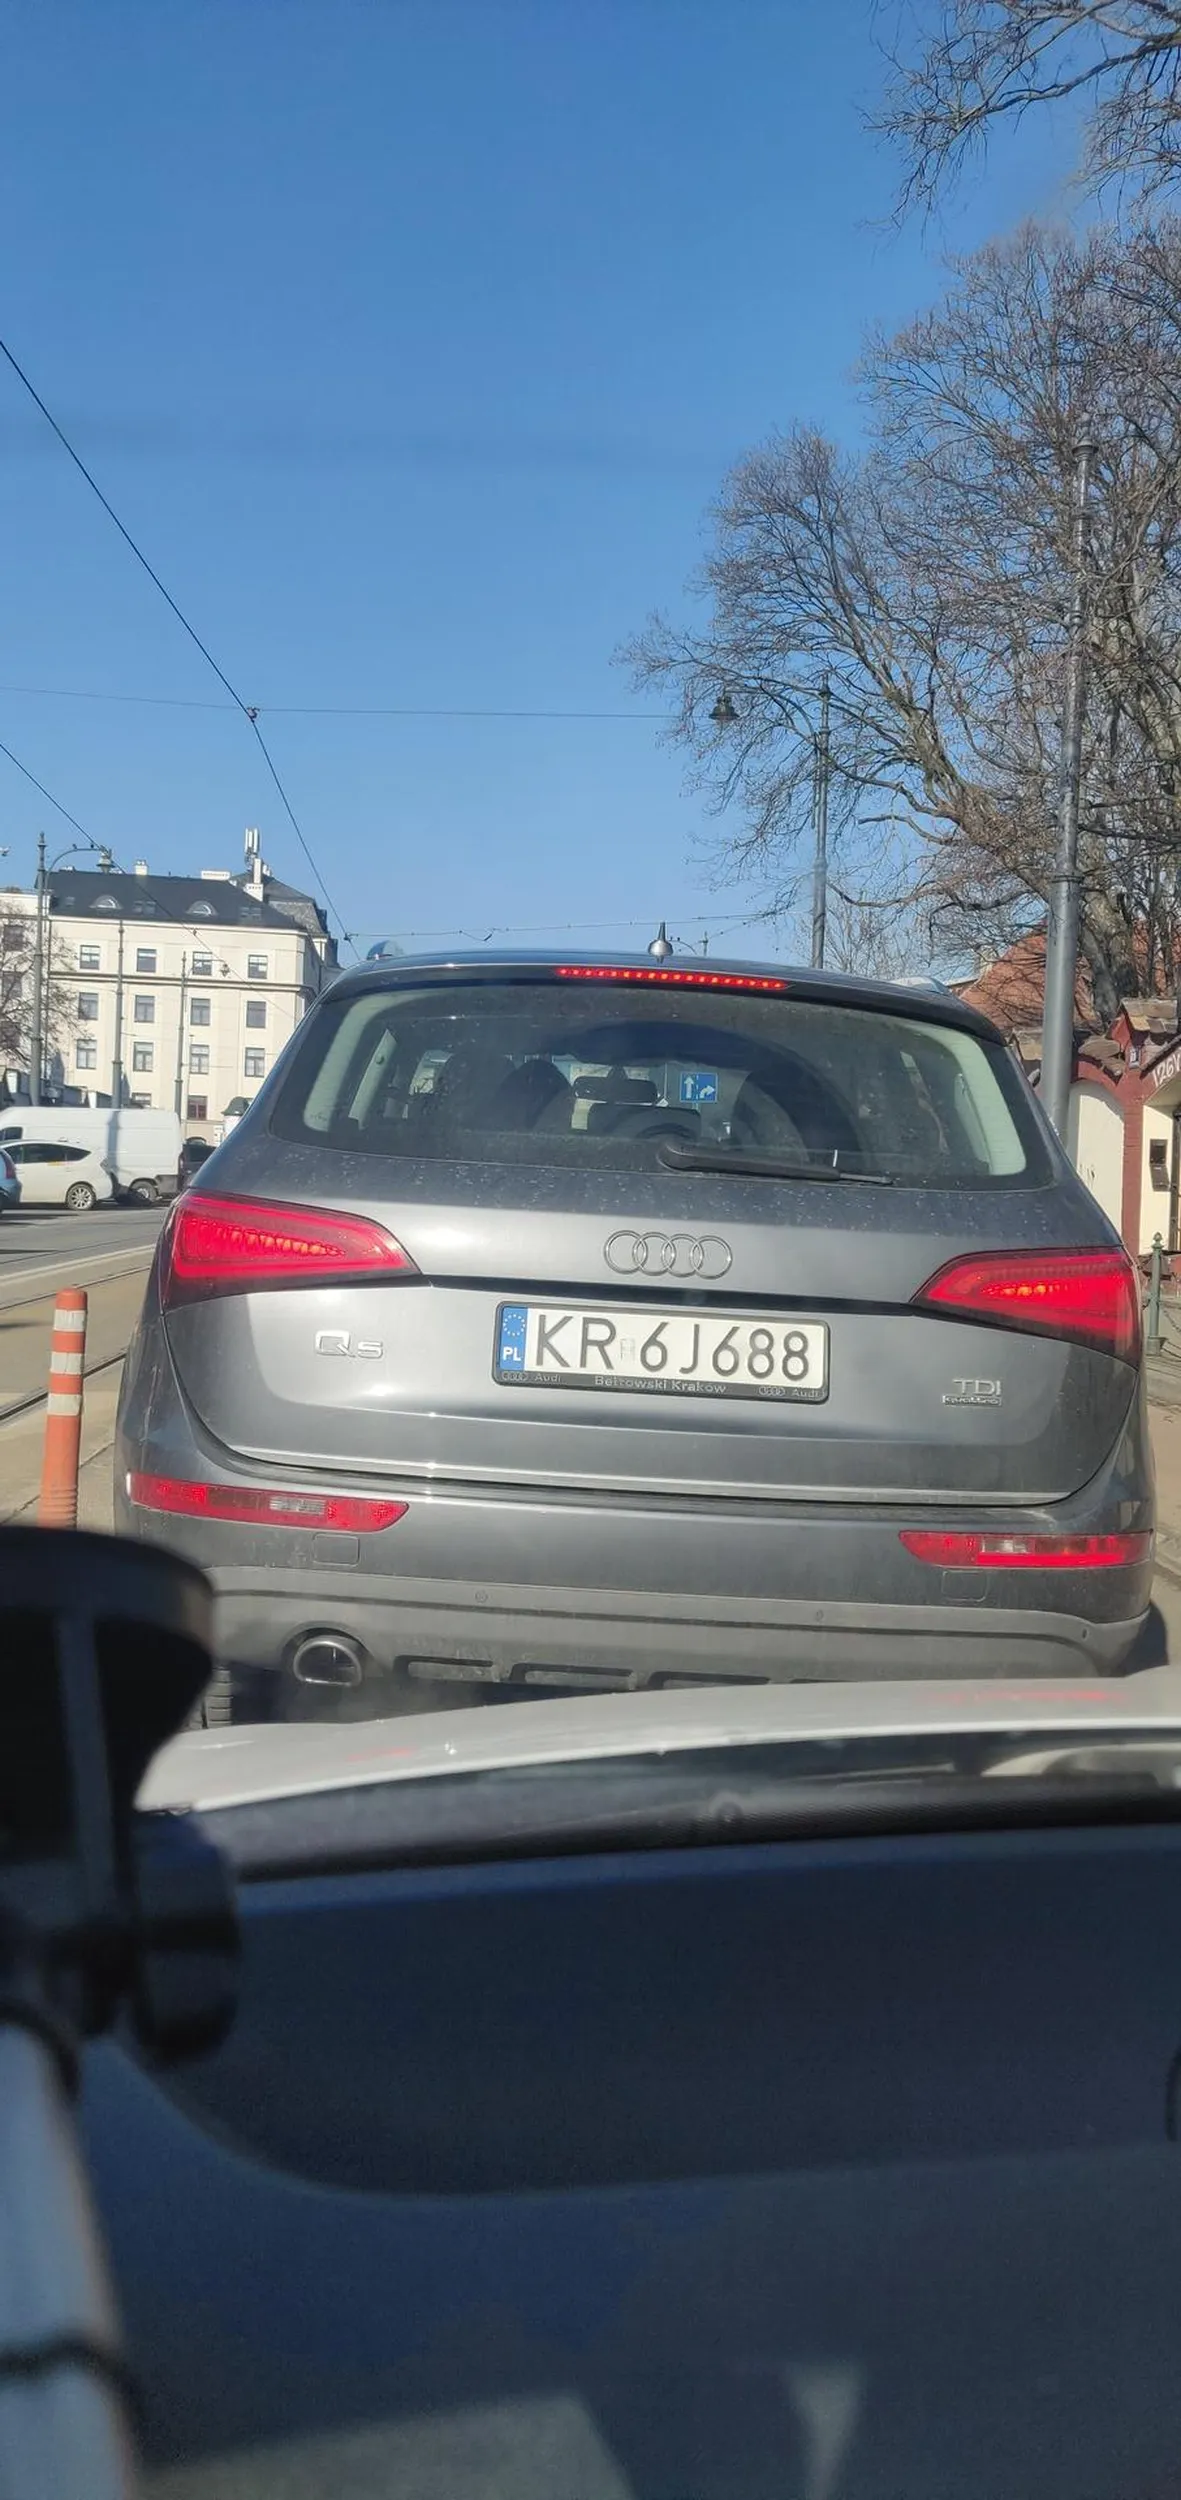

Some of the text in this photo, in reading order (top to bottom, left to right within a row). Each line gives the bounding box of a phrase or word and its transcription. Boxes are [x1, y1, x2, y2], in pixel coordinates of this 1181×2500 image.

[315, 1330, 383, 1359] Q5
[535, 1314, 809, 1381] KR 6J688
[502, 1346, 522, 1361] PL
[534, 1373, 561, 1383] Audi
[791, 1388, 820, 1398] Audi
[952, 1379, 1001, 1395] TDI
